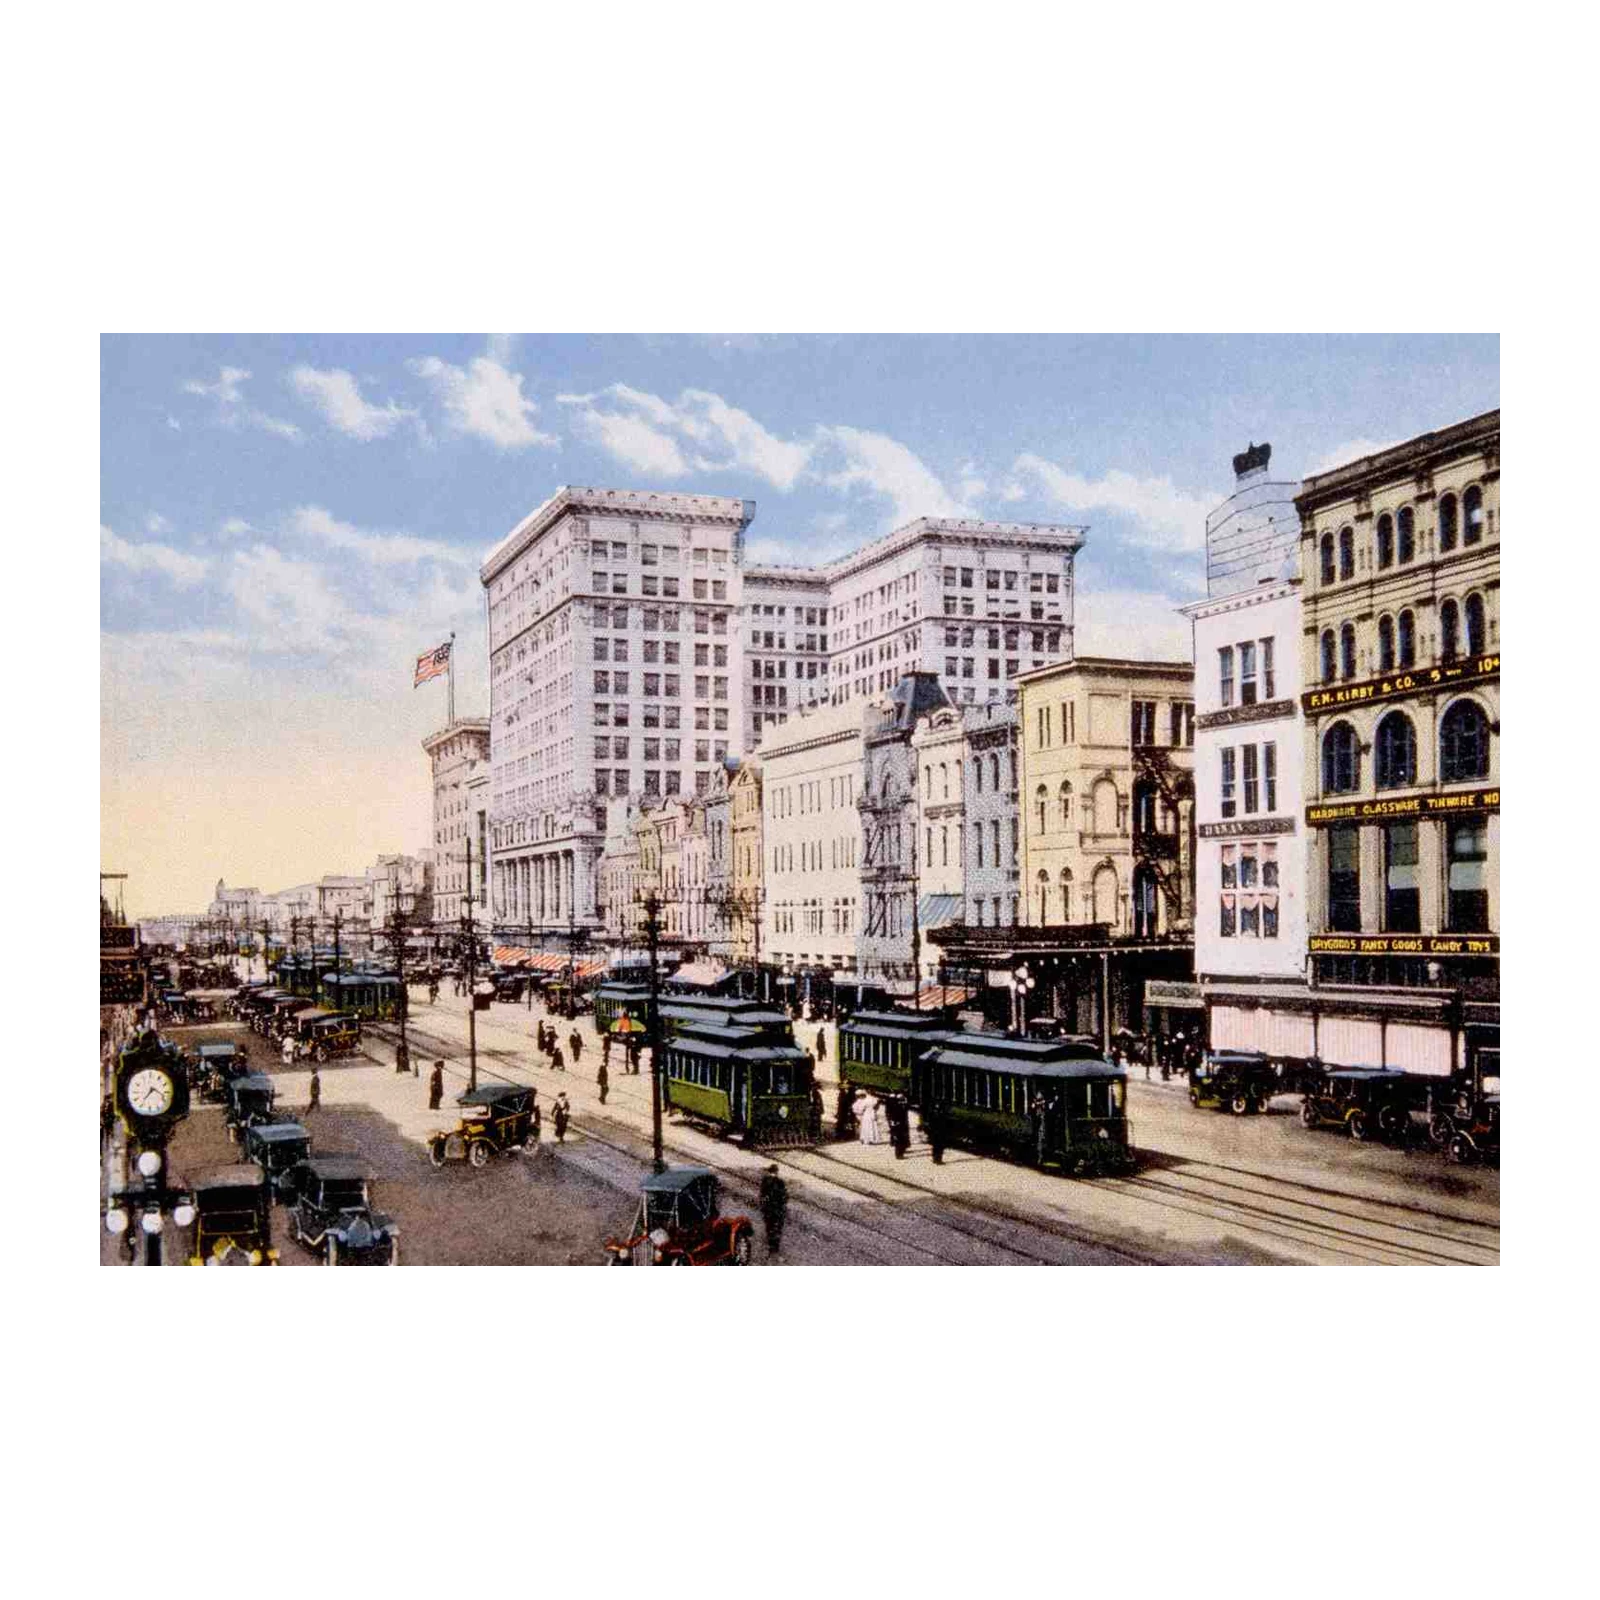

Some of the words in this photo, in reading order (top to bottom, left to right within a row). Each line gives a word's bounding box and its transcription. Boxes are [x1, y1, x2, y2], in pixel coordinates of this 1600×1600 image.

[1336, 685, 1374, 701] KIRBY
[1381, 682, 1392, 693] &
[1395, 676, 1416, 690] CO.
[1430, 669, 1441, 682] 5
[1426, 794, 1476, 808] TINWARE
